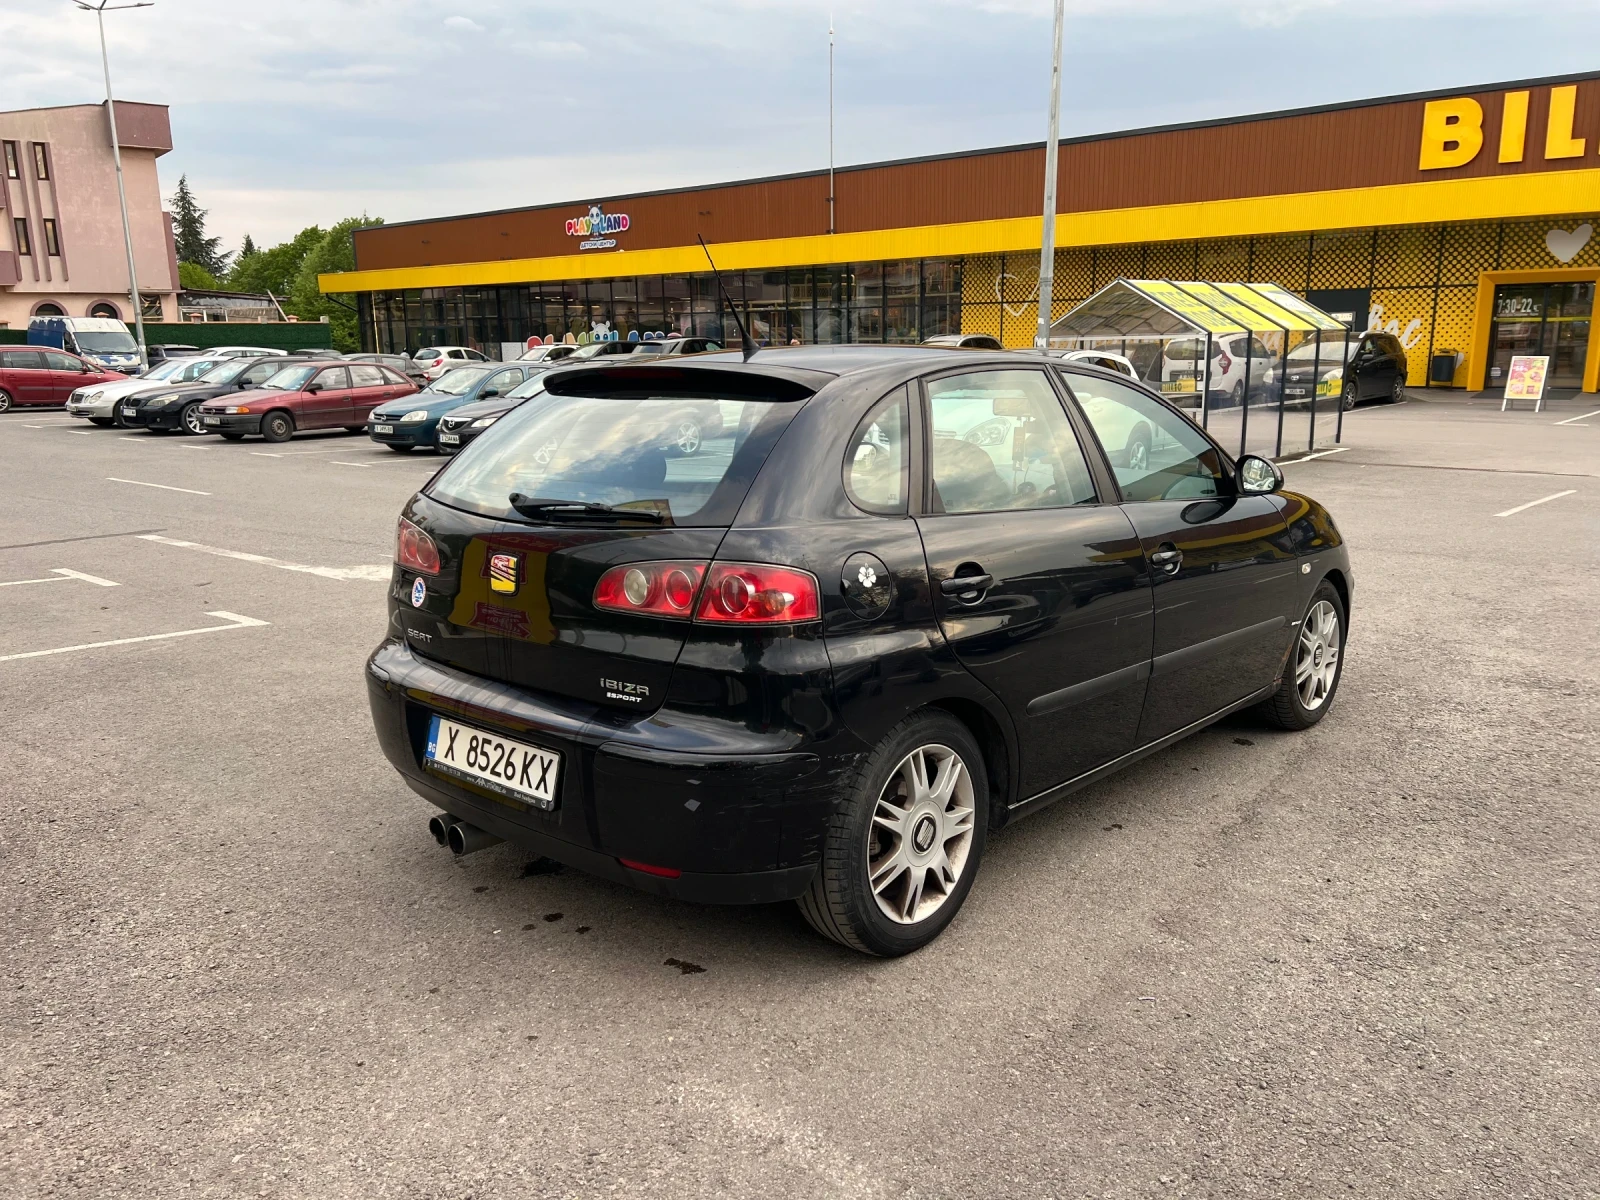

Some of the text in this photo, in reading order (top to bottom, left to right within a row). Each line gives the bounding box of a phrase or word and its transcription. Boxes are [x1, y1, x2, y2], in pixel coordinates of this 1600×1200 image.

[1419, 84, 1600, 171] BIL
[566, 214, 629, 235] PLAY LAND
[408, 628, 432, 643] SEAT
[428, 742, 436, 753] BG
[444, 726, 459, 761] X
[466, 735, 516, 781] 8526
[520, 751, 553, 794] KX
